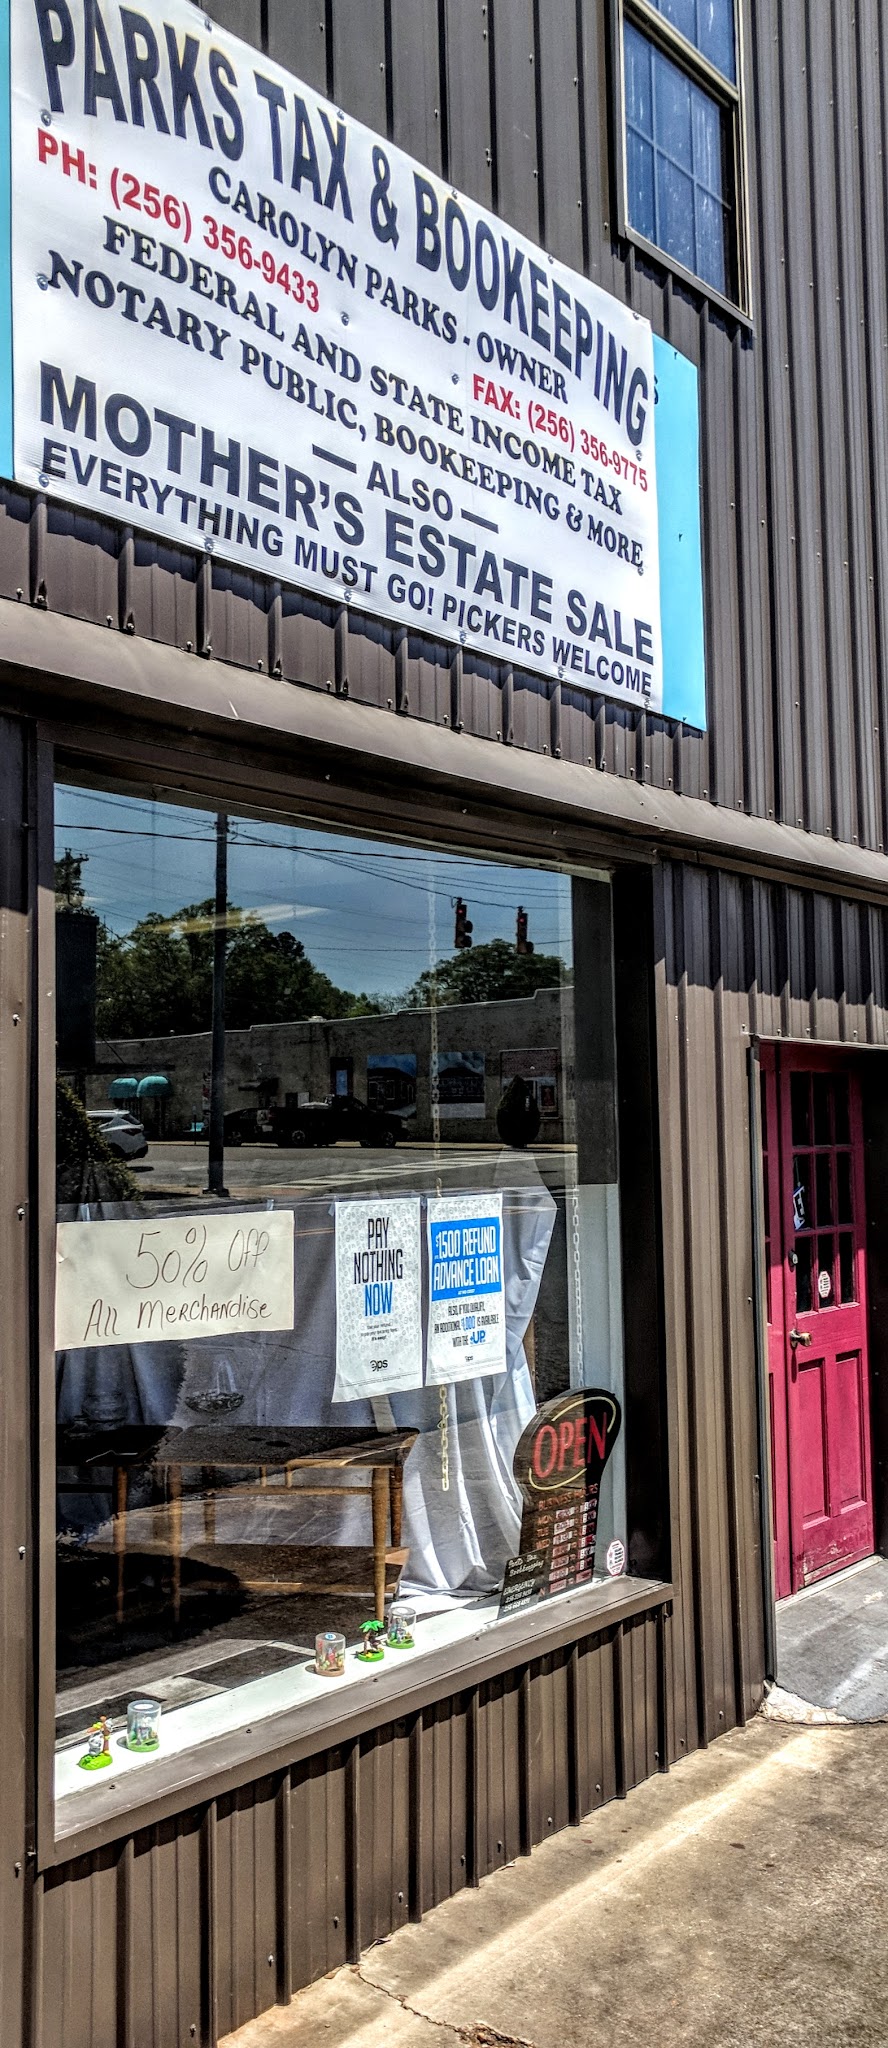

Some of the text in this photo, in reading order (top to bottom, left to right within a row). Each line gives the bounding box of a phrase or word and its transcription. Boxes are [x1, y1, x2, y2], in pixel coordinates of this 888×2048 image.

[35, 0, 649, 446] PARKS TAX & BOOKEEPING
[37, 127, 319, 313] PH: (256) 356-9433
[207, 166, 358, 288] CAROLYN
[365, 263, 458, 345] PARKS
[476, 332, 569, 404] OWNER
[48, 250, 644, 568] NOTARY PUBLIC, BOOKEEPING & MORE
[102, 215, 623, 515] FEDERAL AND STATE INCOME TAX
[472, 374, 649, 492] FAX: (256) 356-9775
[39, 360, 654, 666] MOTHER'S ESTATE SALE
[366, 460, 452, 521] ALSO
[42, 437, 652, 698] EVERYTHING MUST GO! PICKERS WELCOME
[126, 1224, 209, 1290] 50%
[353, 1248, 403, 1285] NOTHING
[367, 1216, 390, 1250] PAY
[433, 1255, 499, 1291] ADVANCE LOAN
[462, 1225, 496, 1256] REFUND
[364, 1282, 393, 1317] NOW
[533, 1412, 607, 1478] OPEN
